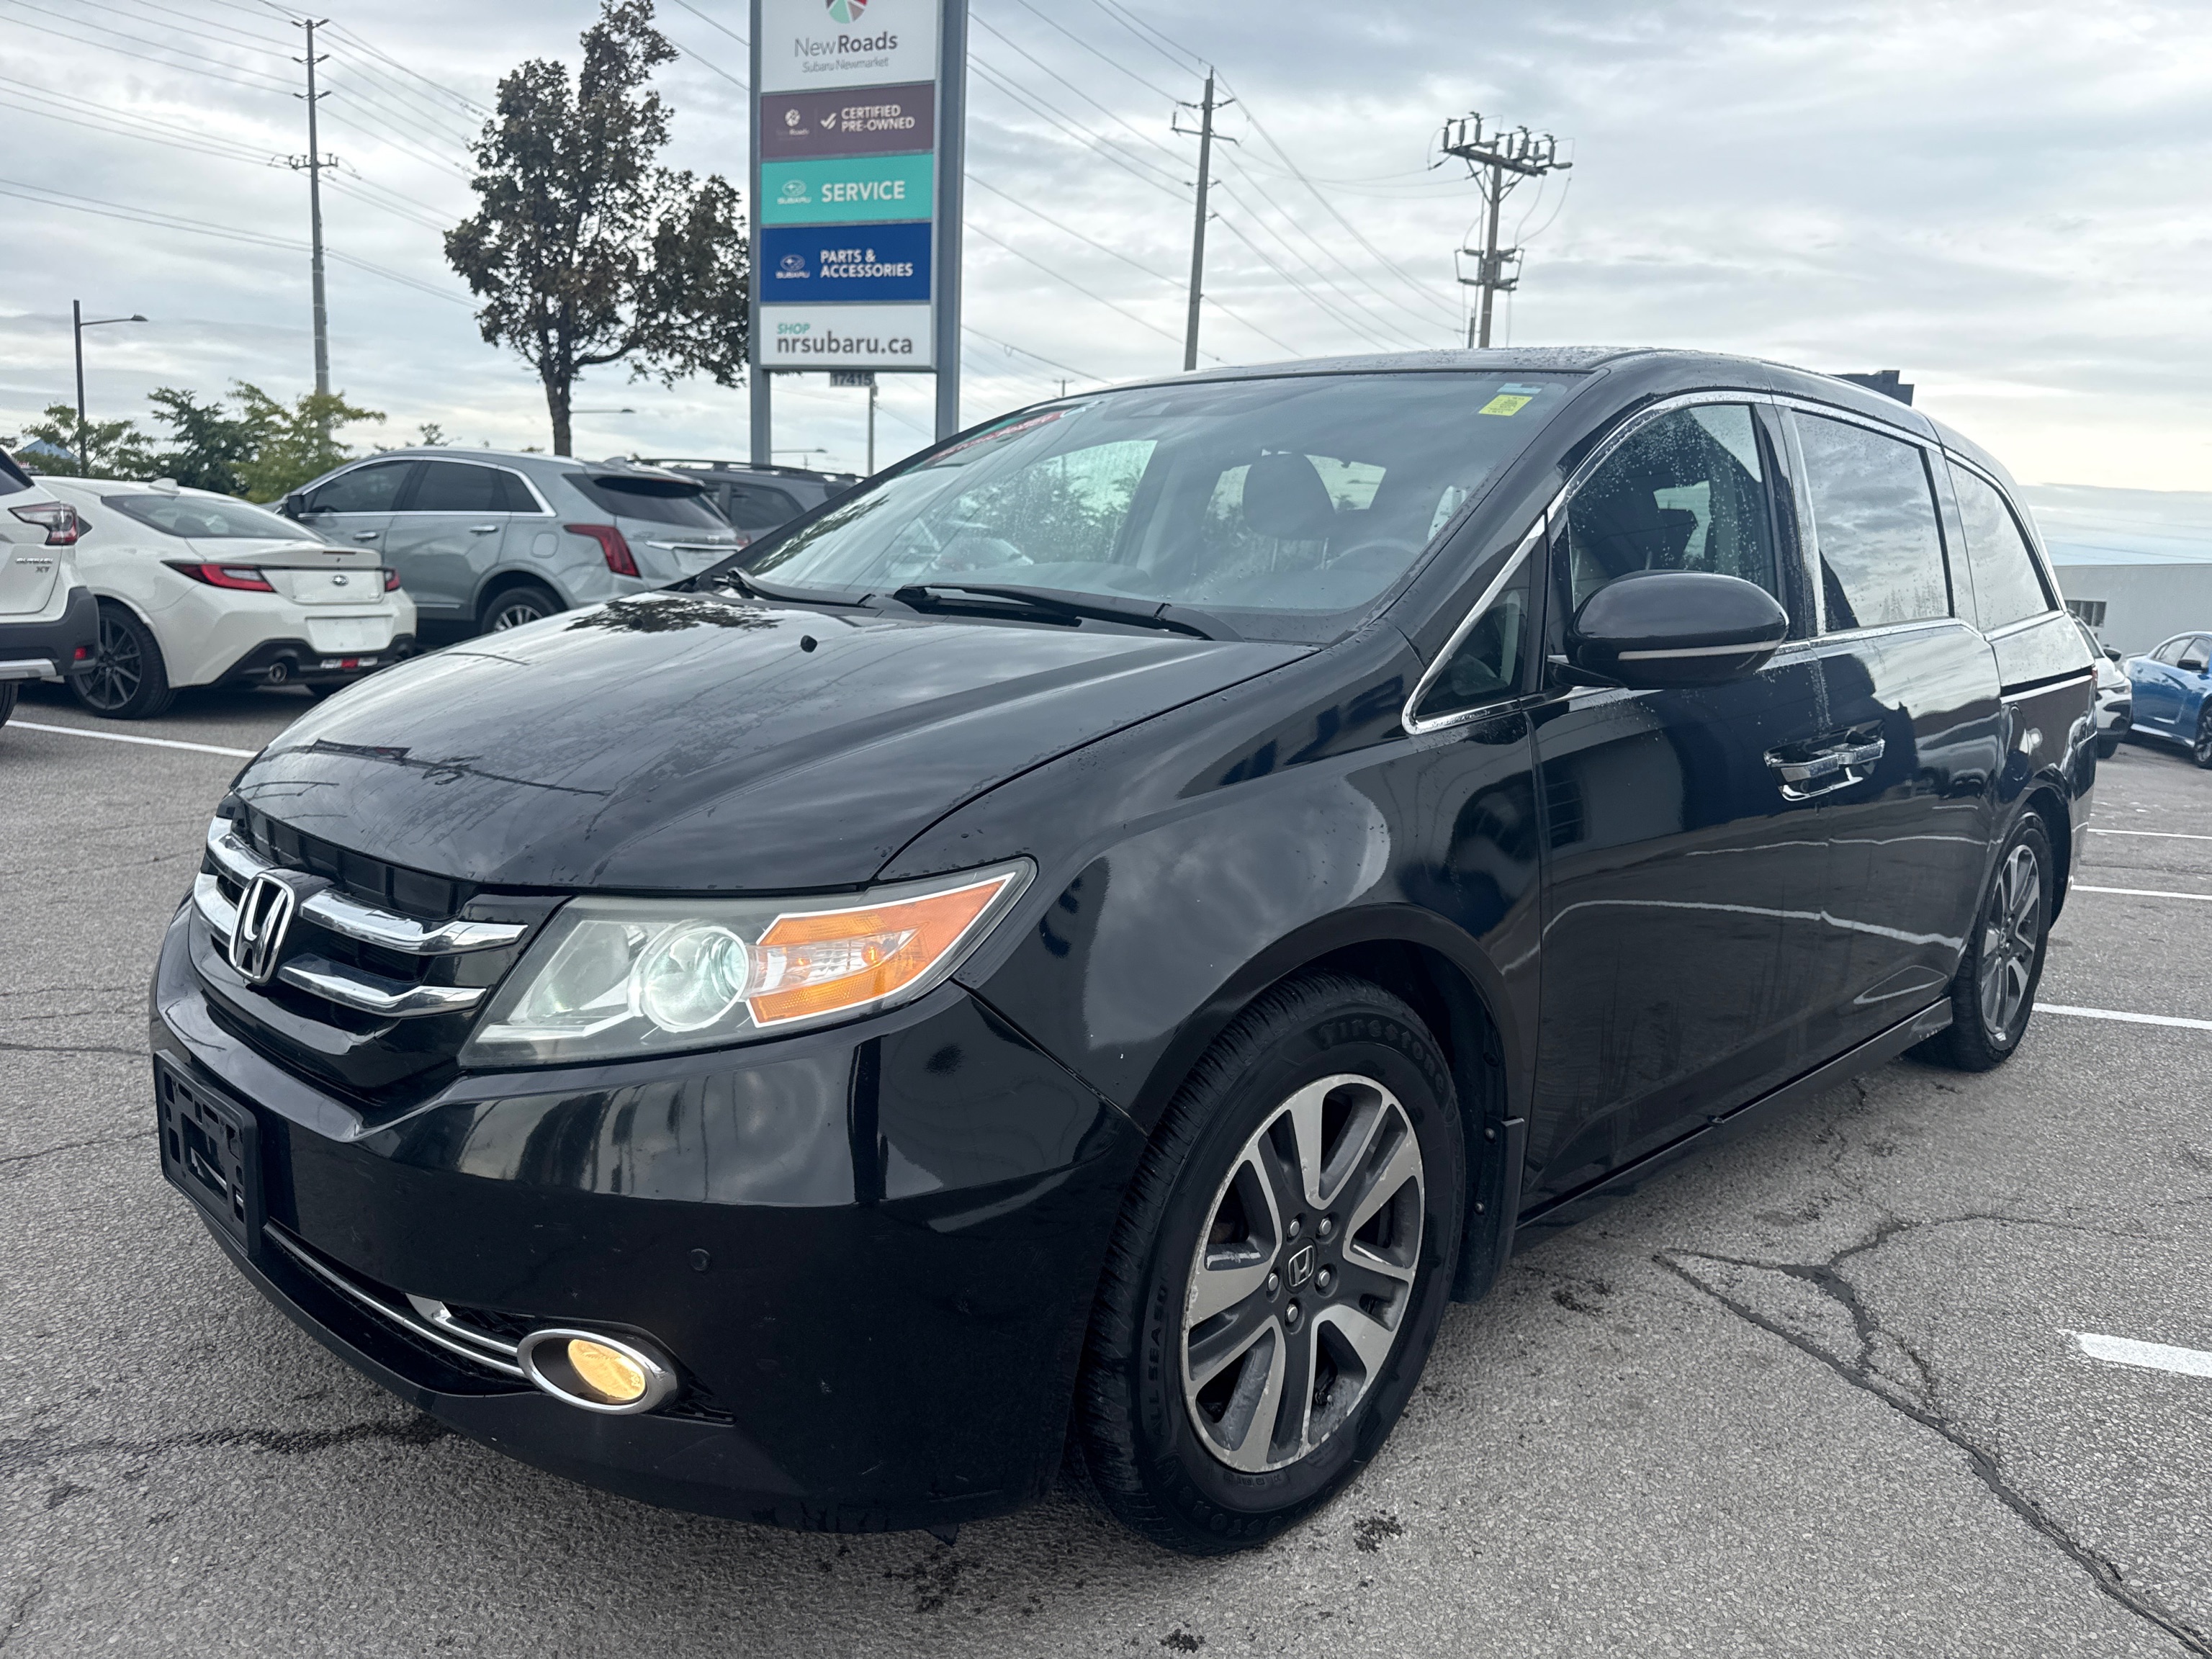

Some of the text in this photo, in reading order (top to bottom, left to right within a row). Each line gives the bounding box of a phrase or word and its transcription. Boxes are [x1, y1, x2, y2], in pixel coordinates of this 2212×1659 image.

[835, 56, 889, 70] Newmarket
[841, 104, 902, 120] CERTIFIED
[841, 117, 915, 132] PRE-OWNED
[821, 181, 905, 202] SERVICE
[820, 249, 876, 264] PARTS &
[820, 263, 913, 278] ACCESSORIES
[777, 323, 811, 334] SHOP
[777, 331, 912, 354] nrsubaru.ca
[832, 372, 873, 385] 17415
